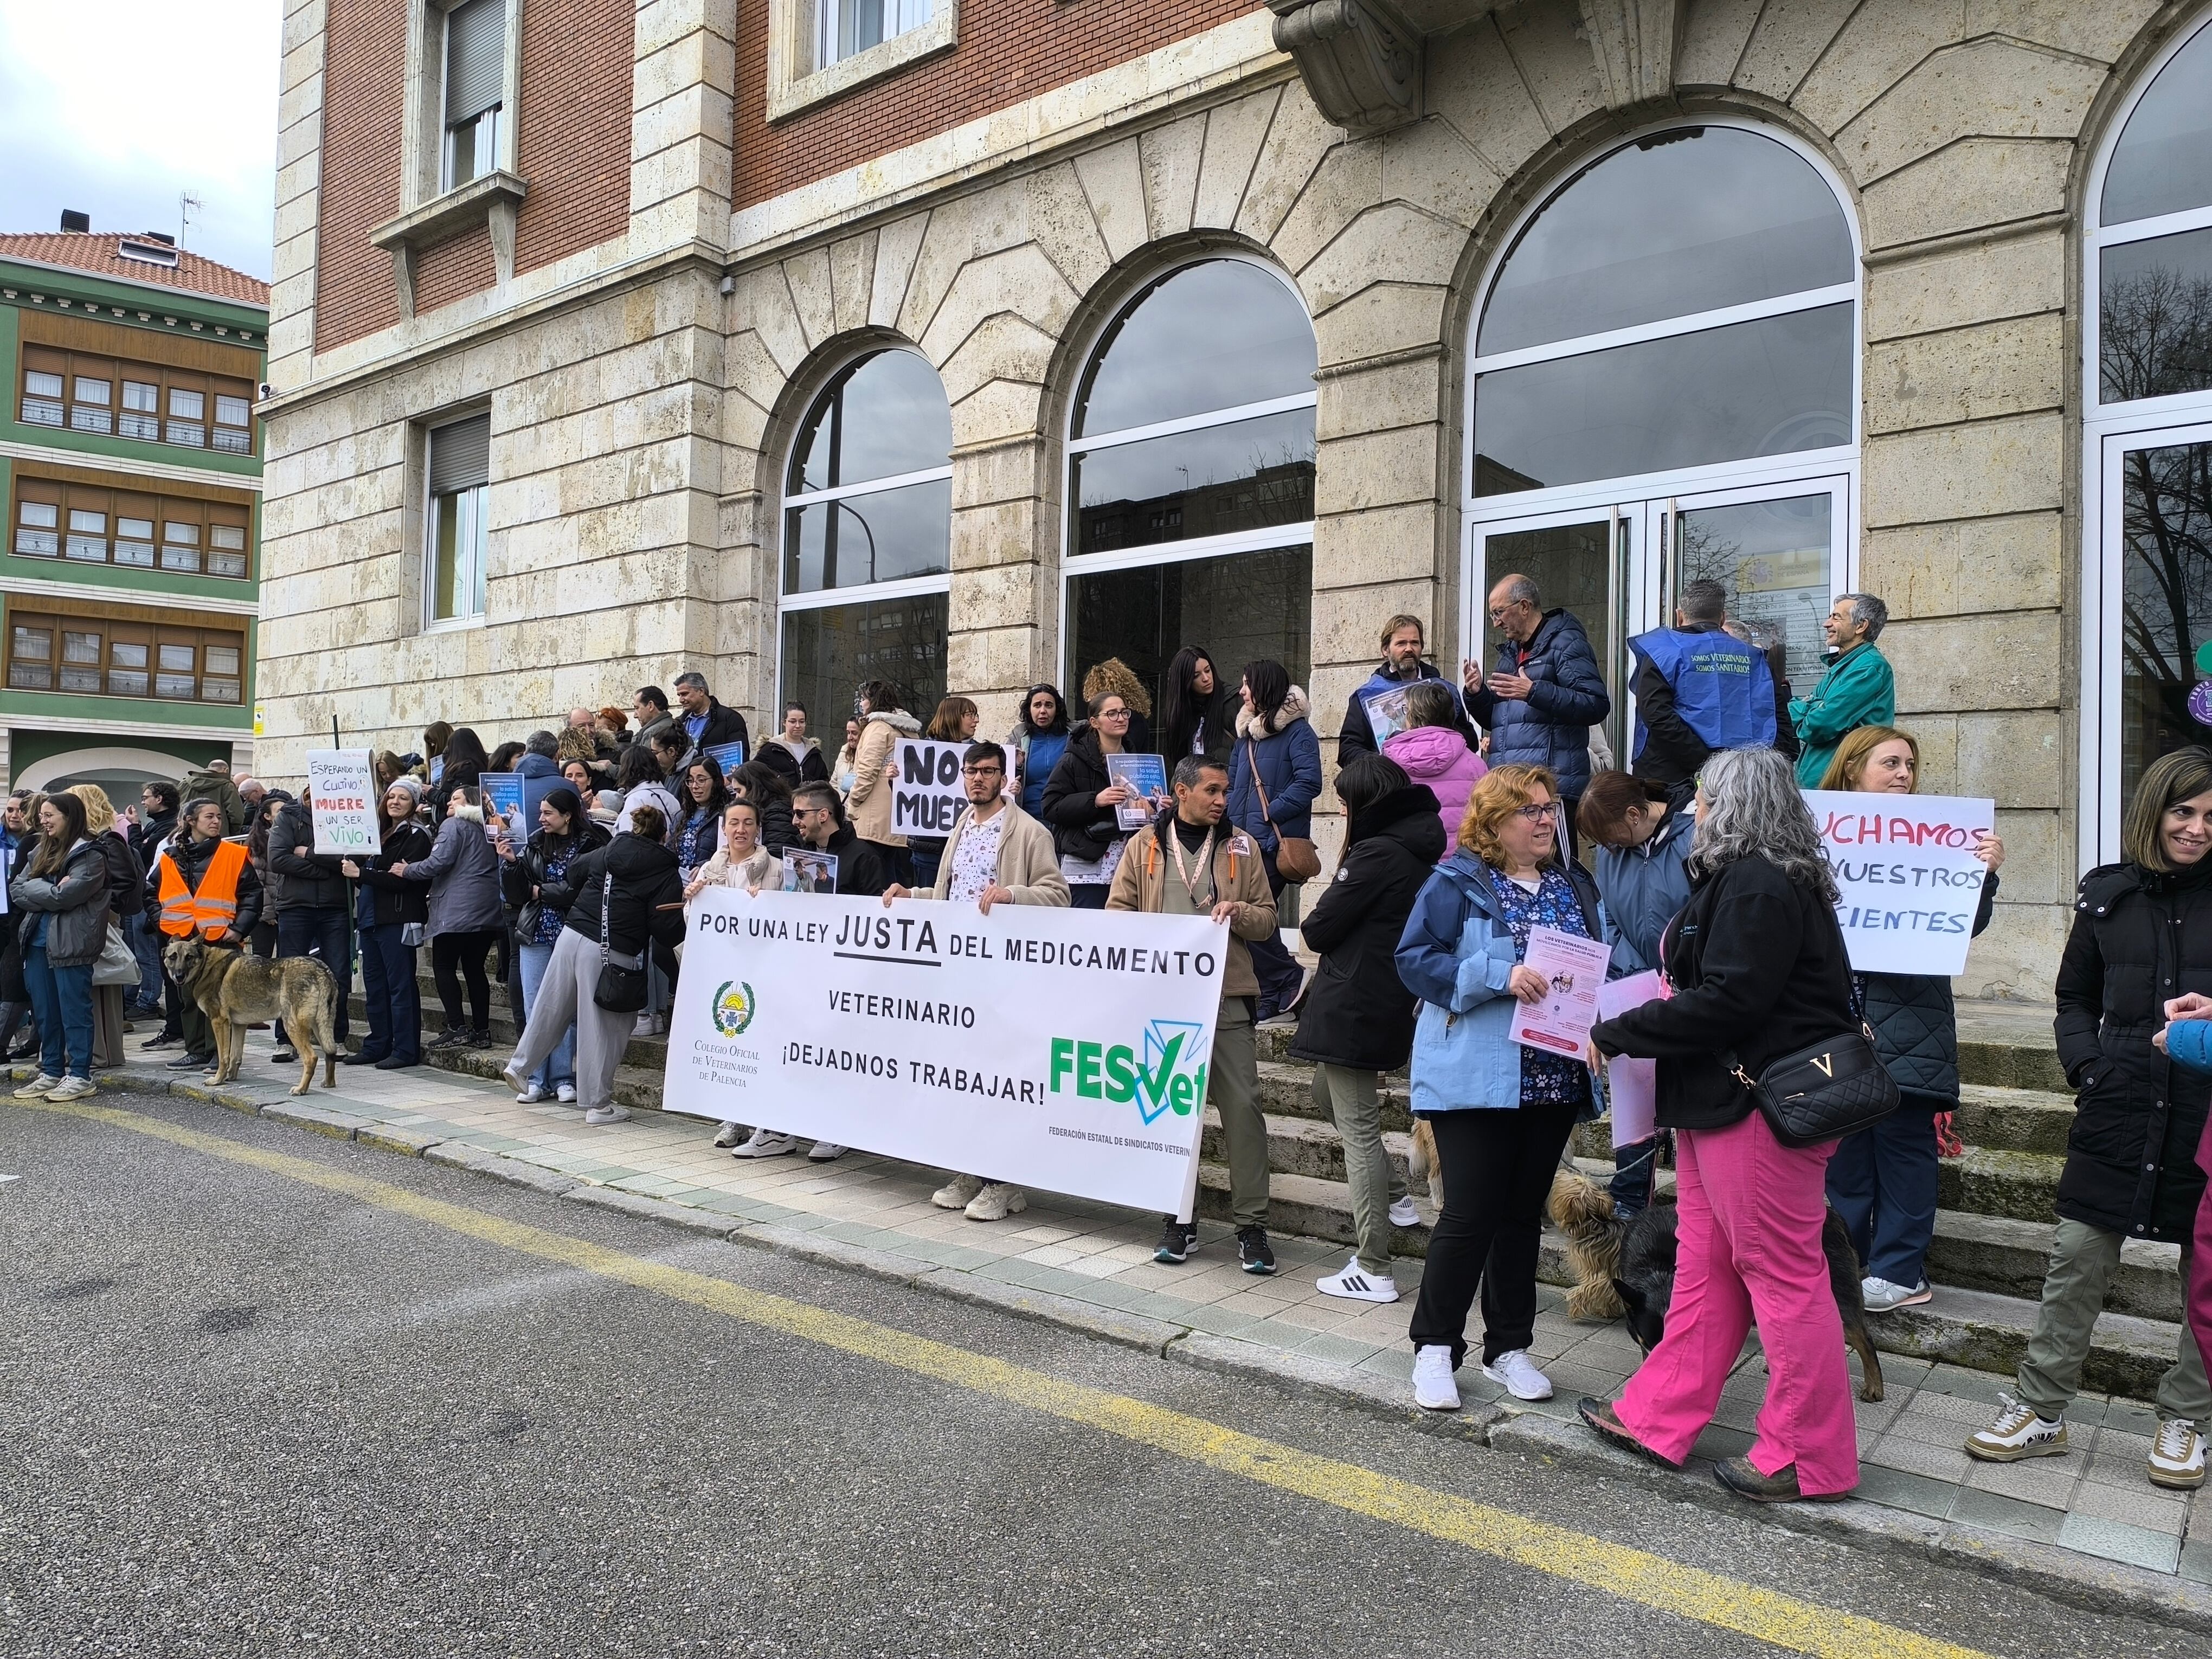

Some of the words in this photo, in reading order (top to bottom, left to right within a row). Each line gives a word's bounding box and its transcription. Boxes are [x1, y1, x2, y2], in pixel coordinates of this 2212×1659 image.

[1715, 663, 1750, 673] SANITARIOS
[2190, 681, 2209, 700] PUNTO
[311, 761, 352, 775] ESPERANDO
[357, 765, 368, 774] UN
[904, 745, 959, 786] NO
[315, 798, 364, 811] MUERE
[897, 791, 969, 831] MUER
[326, 815, 337, 825] UN
[343, 816, 364, 825] SER
[1817, 812, 1989, 851] UCHAMOS
[700, 914, 739, 935] POR
[749, 918, 788, 940] UNA
[796, 922, 829, 943] LEY
[836, 915, 937, 954] JUSTA
[950, 934, 993, 959] DEL
[1005, 938, 1215, 976] MEDICAMENTO
[1555, 938, 1587, 951] VETERINARIOS
[829, 990, 975, 1028] VETERINARIO
[695, 1040, 727, 1054] COLEGIO
[730, 1045, 760, 1060] OFICIAL
[692, 1056, 703, 1065] DE
[706, 1056, 758, 1075] VETERINARIOS
[783, 1042, 898, 1079] ¡DEJADNOS
[910, 1061, 1044, 1105] TRABAJAR!
[1809, 1053, 1832, 1077] V
[699, 1072, 709, 1081] DE
[711, 1071, 746, 1088] PALENCIA
[1049, 1126, 1086, 1140] FEDERACIÓN
[1088, 1133, 1113, 1144] ESTATAL
[1114, 1136, 1123, 1146] DE
[1124, 1138, 1163, 1152] SINDICATOS
[1165, 1144, 1190, 1157] VETERIN
